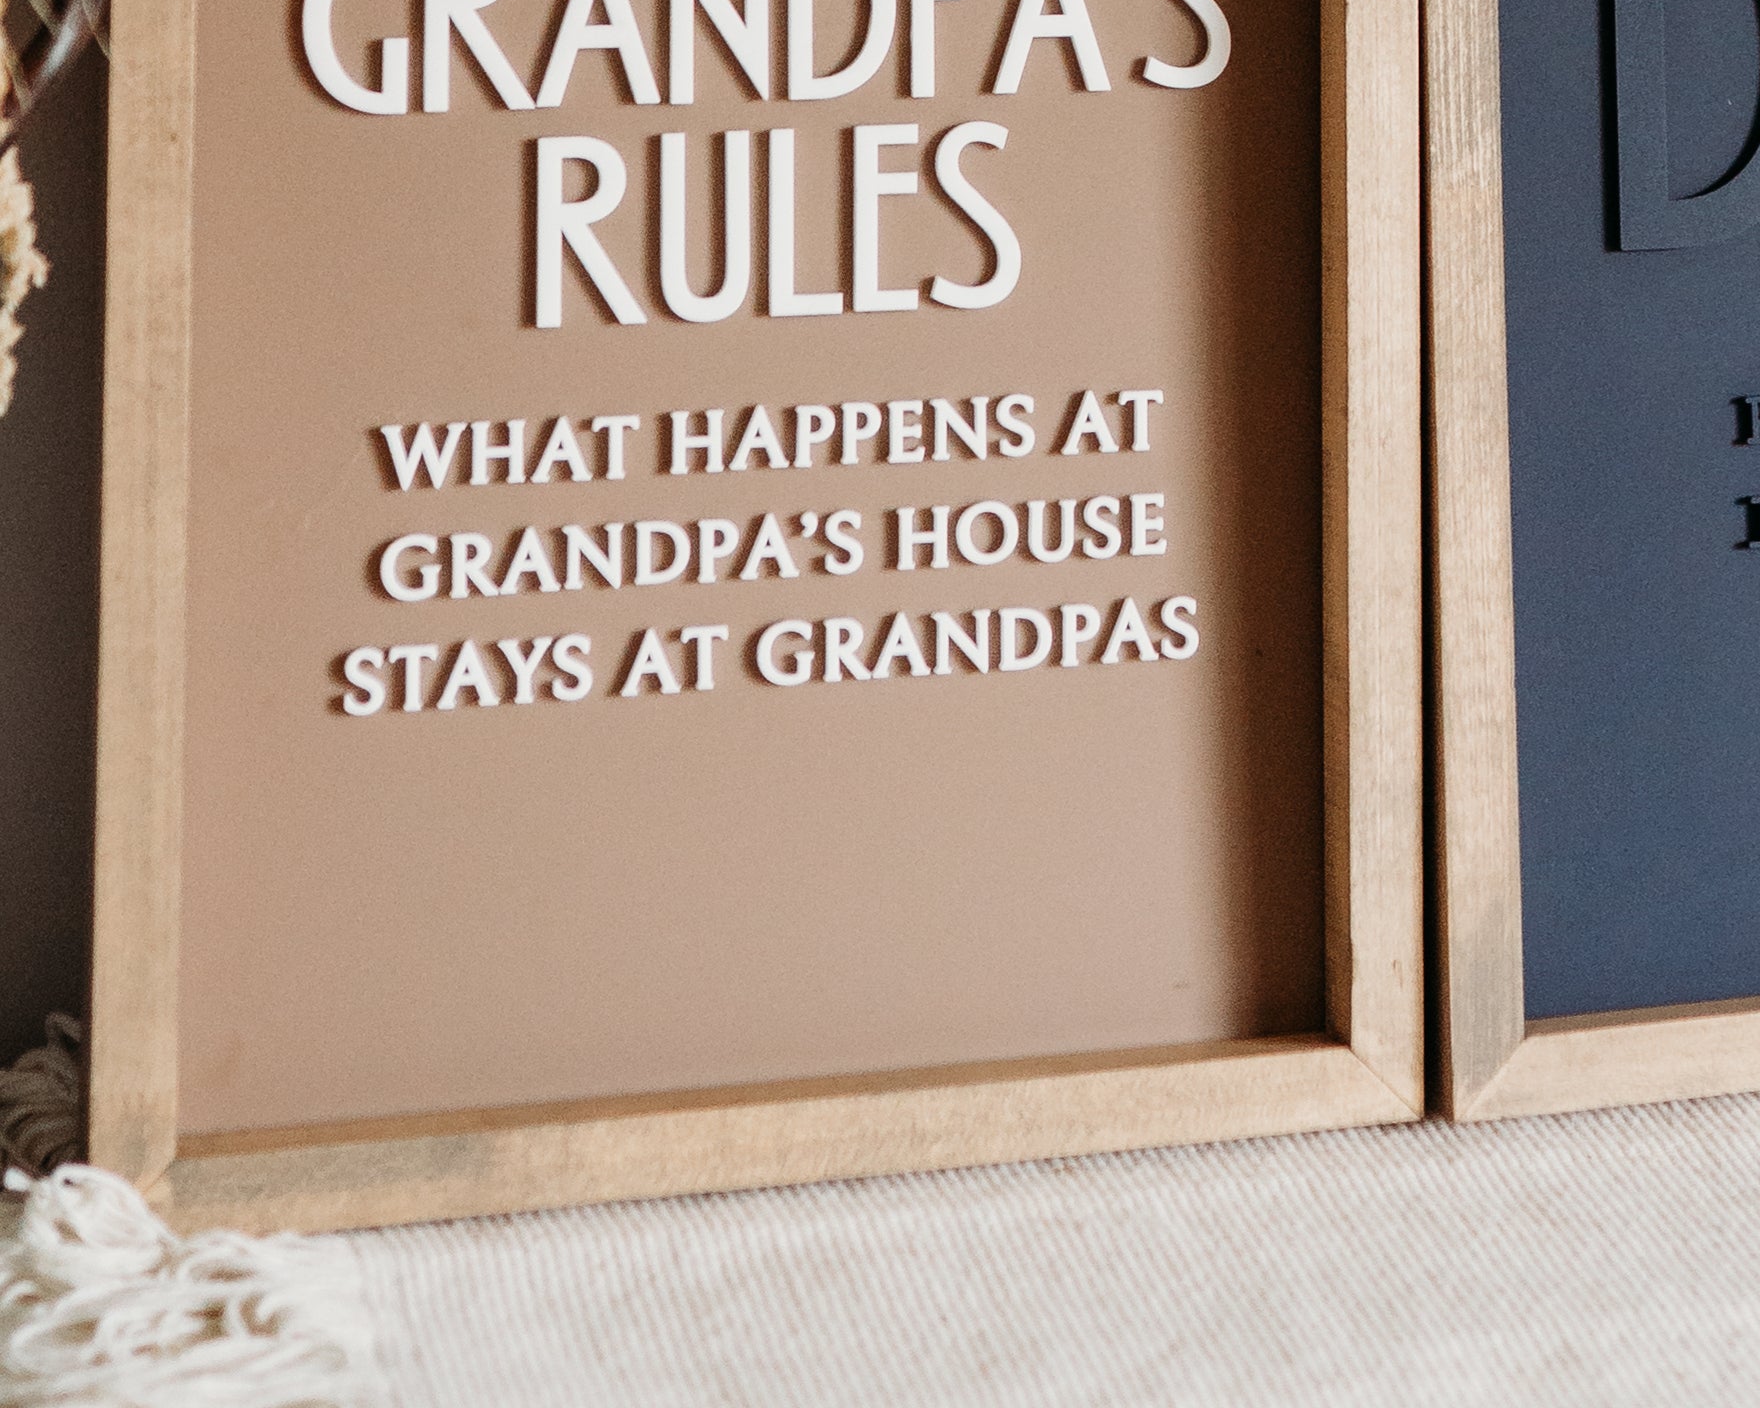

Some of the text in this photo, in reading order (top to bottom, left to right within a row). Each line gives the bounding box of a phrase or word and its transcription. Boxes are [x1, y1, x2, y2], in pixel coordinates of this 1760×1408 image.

[532, 120, 1022, 329] RULES
[379, 388, 1164, 492] WHAT HAPPENS AT
[376, 492, 1167, 603] GRANDPA’S HOUSE
[334, 596, 1200, 716] STAYS AT GRANDPAS
